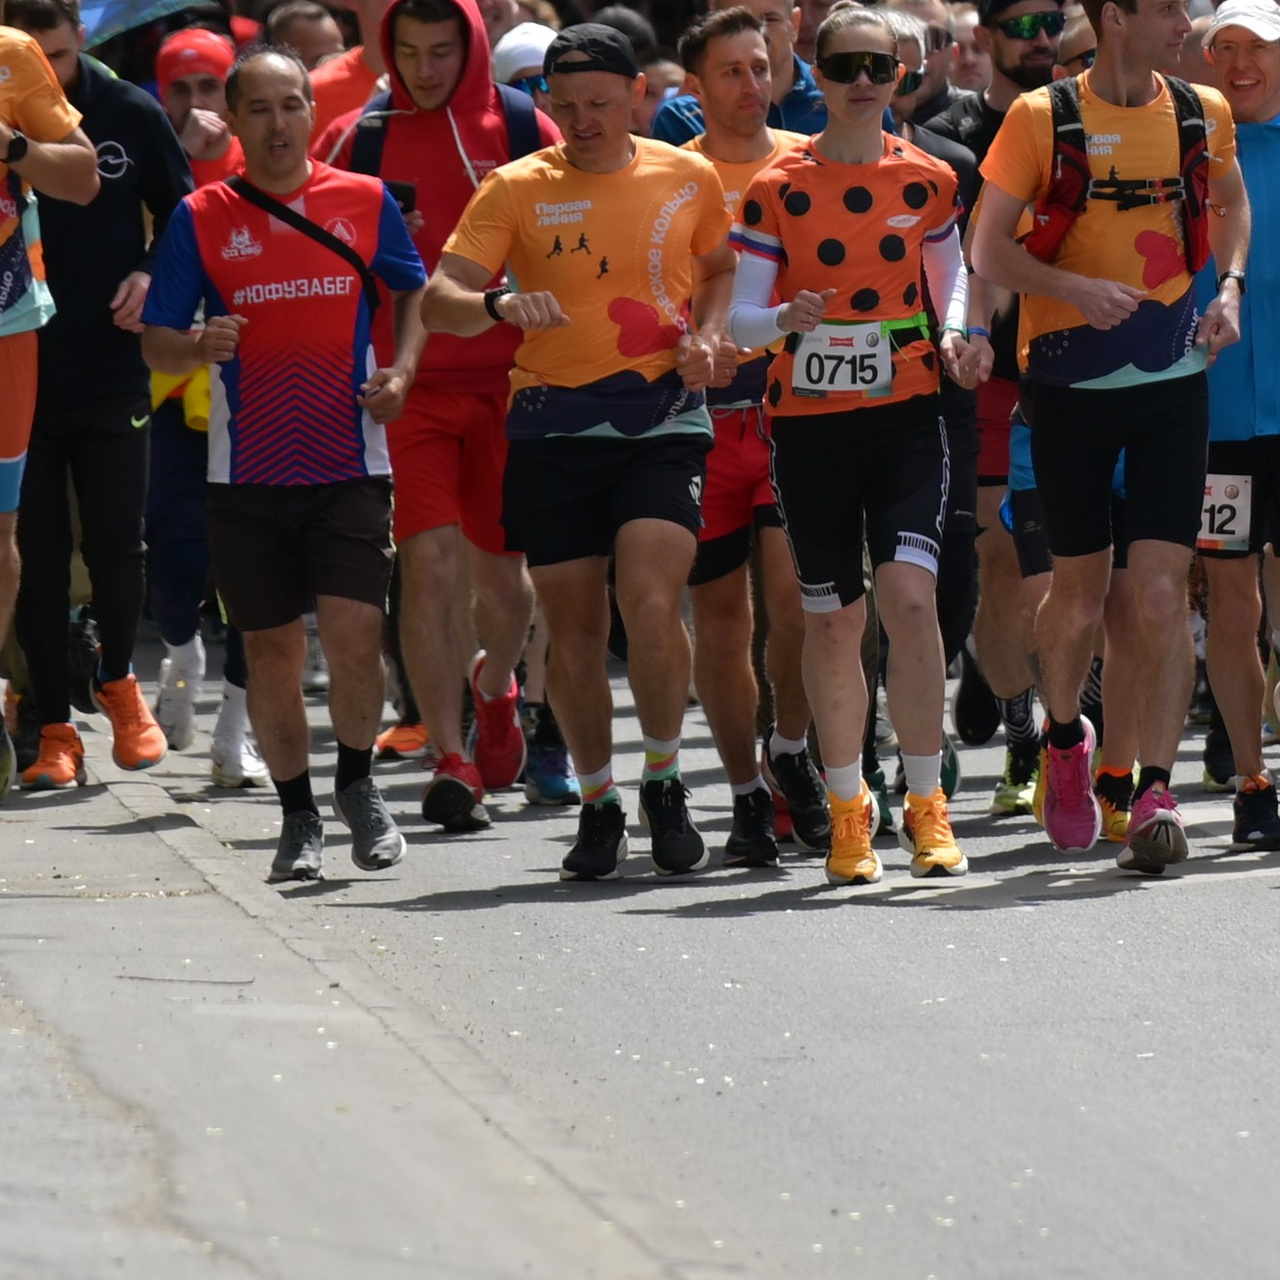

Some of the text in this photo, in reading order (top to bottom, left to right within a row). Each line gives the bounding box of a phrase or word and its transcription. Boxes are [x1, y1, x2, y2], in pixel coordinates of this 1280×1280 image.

[1086, 144, 1113, 155] ния
[535, 200, 592, 215] Первая
[537, 212, 583, 226] линия
[650, 181, 698, 245] кольцо
[233, 276, 354, 306] #ЮФУЗАБЕГ
[806, 352, 878, 385] 0715
[1202, 504, 1236, 535] 12
